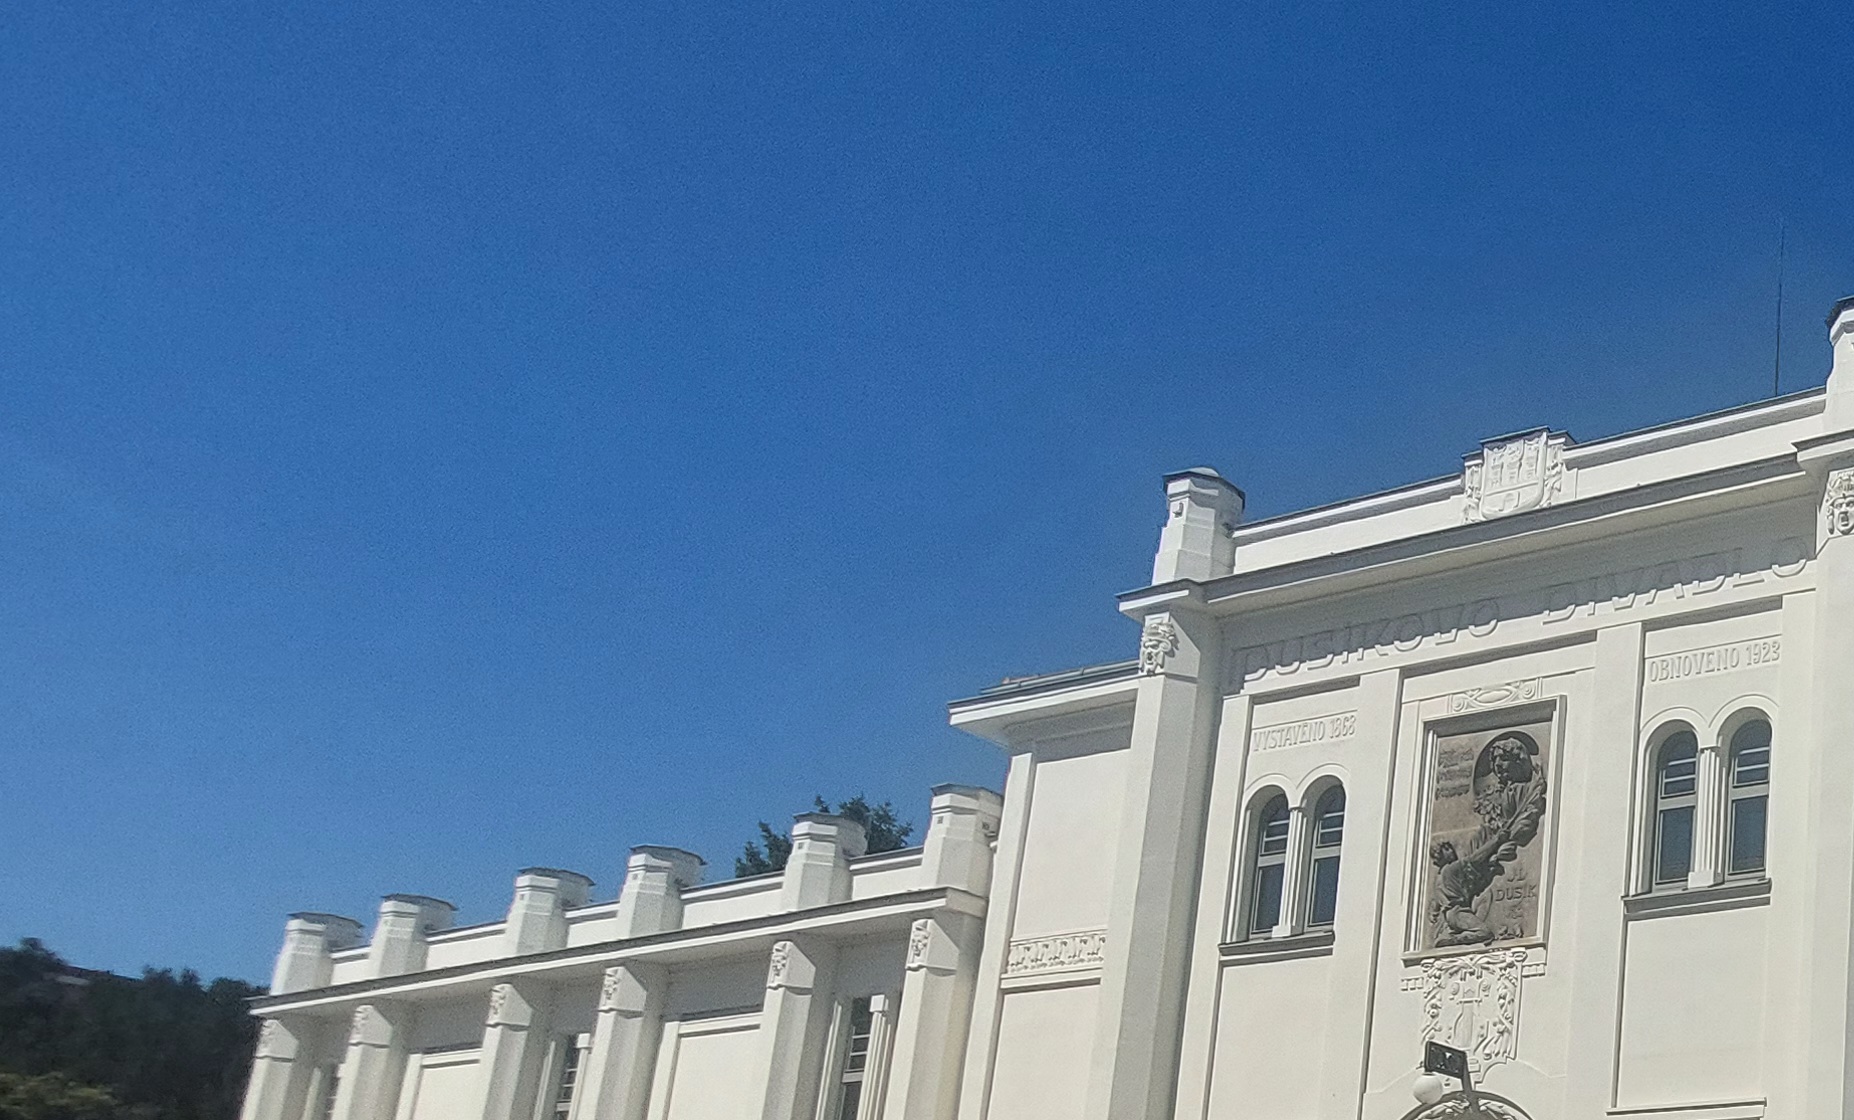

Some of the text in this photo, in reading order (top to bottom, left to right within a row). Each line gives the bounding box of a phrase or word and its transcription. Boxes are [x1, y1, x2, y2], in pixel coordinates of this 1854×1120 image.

[1541, 535, 1808, 625] DIVADLO
[1649, 641, 1780, 682] OBNOVENO 1923
